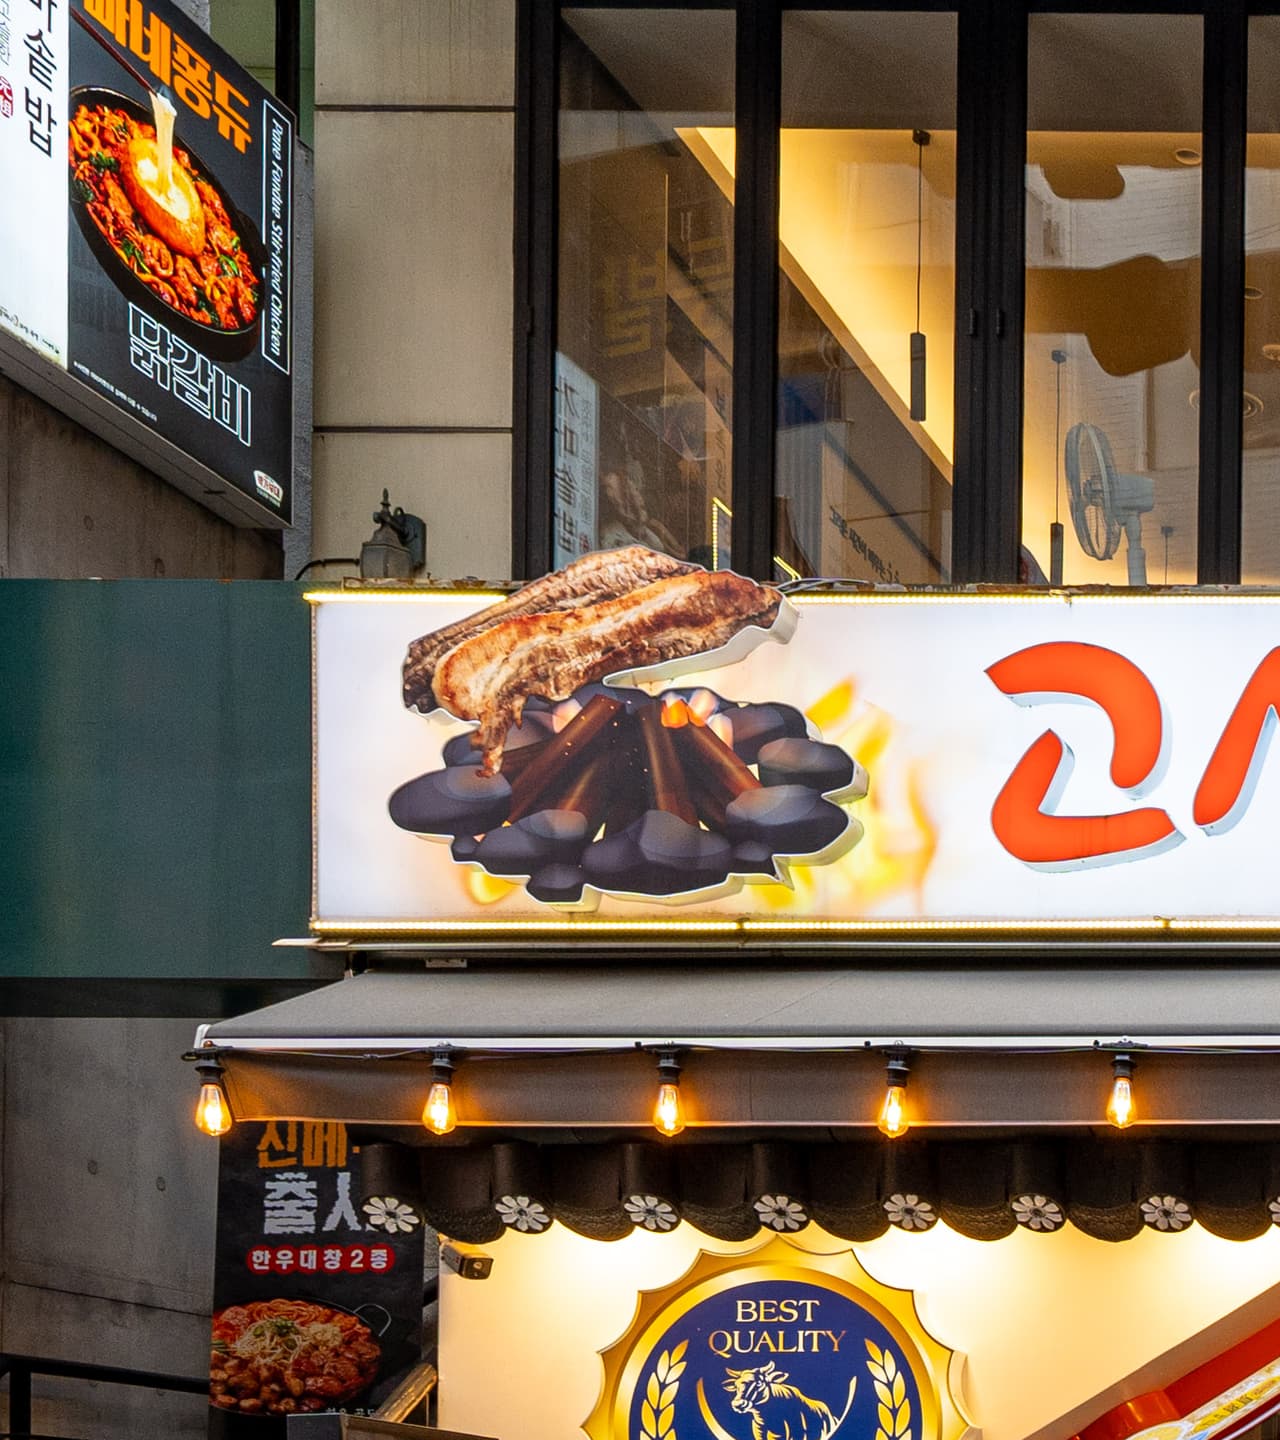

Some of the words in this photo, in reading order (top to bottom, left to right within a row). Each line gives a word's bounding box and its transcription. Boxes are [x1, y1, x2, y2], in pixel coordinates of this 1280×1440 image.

[271, 118, 284, 160] Pane
[271, 159, 284, 219] Fondue
[271, 222, 284, 292] Stir-fried
[271, 293, 284, 357] Chicken
[129, 302, 251, 447] 닭갈비
[256, 1121, 361, 1168] 신메
[735, 1299, 820, 1324] BEST
[708, 1330, 847, 1359] QUALITY
